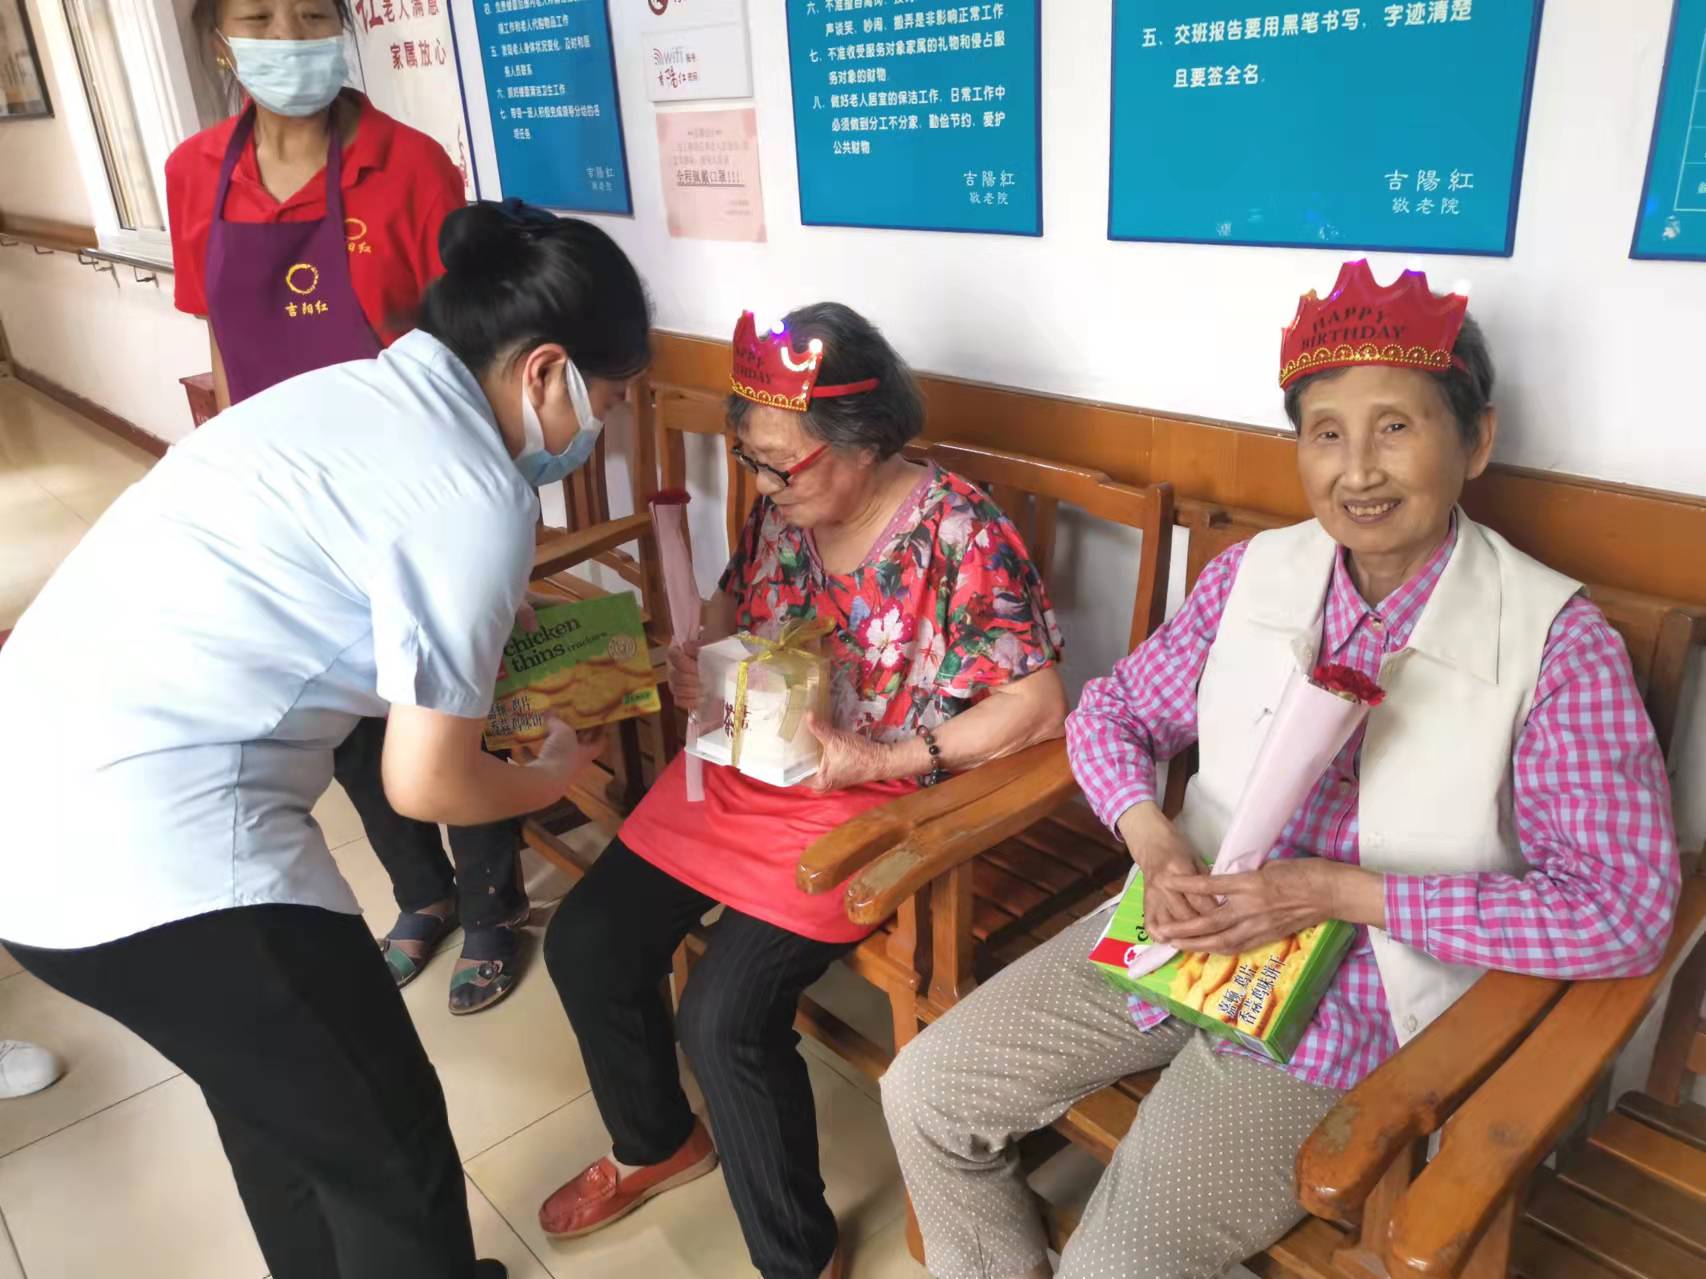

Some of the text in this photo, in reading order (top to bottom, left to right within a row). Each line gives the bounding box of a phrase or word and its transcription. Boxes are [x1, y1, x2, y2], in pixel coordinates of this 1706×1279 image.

[390, 38, 447, 70] 家属放心
[1392, 197, 1460, 215] 敬老院
[285, 300, 328, 317] 吉阳红
[1312, 305, 1391, 335] HAPPY
[1302, 324, 1407, 349] BIRTHDAY
[503, 617, 582, 657] chicken
[511, 643, 566, 673] thins
